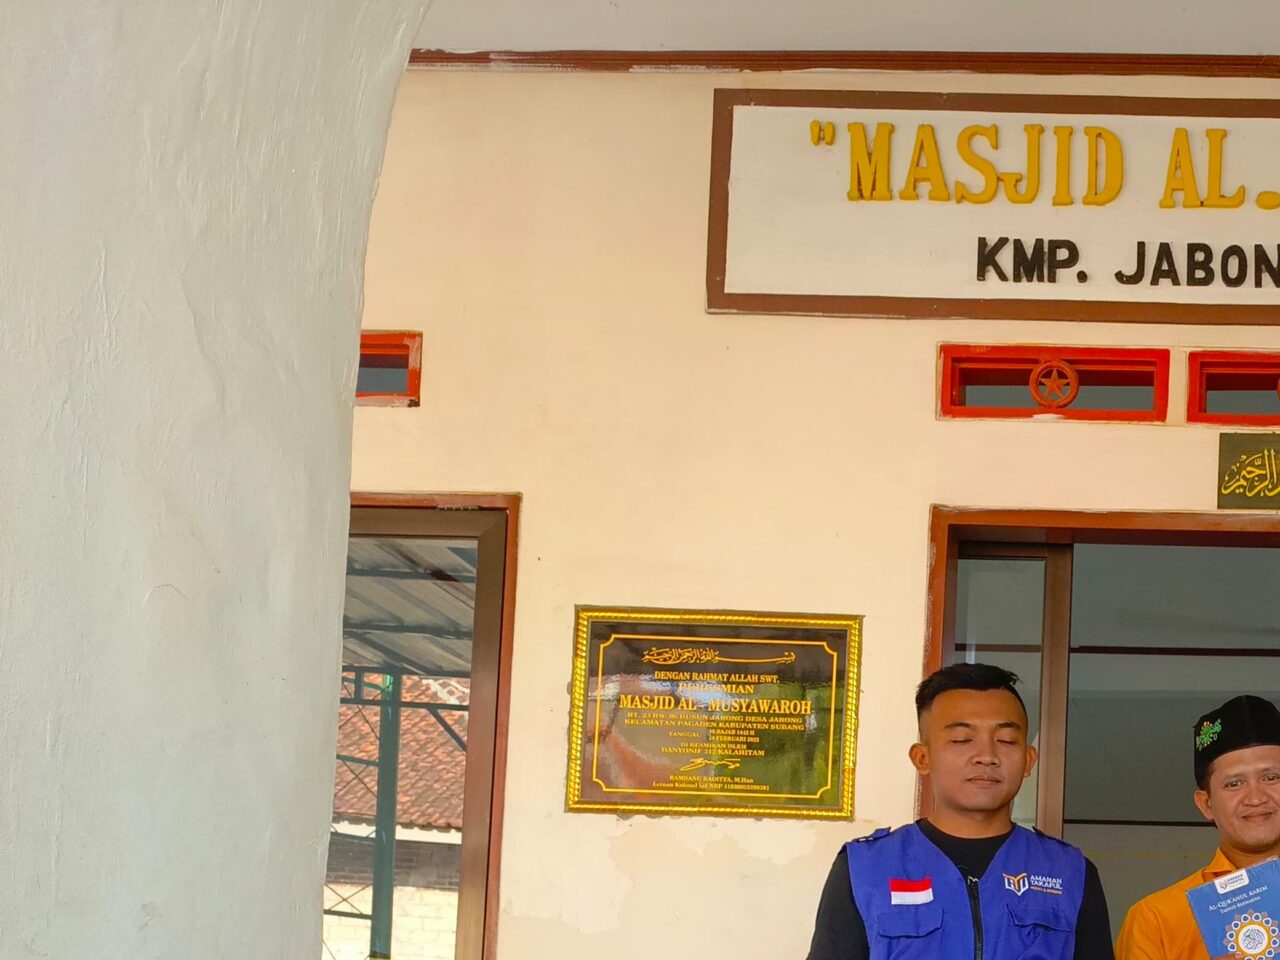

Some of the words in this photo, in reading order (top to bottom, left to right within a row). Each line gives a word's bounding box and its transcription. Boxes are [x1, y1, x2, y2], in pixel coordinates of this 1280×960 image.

[976, 236, 1088, 284] KMP.
[654, 671, 690, 681] DENGAN
[692, 672, 729, 682] RAHMAT
[729, 673, 758, 683] ALLAH
[618, 694, 675, 711] MASJID
[707, 698, 812, 715] MUSYAWAROH
[745, 715, 767, 723] DESA
[1030, 875, 1062, 884] AMANAH
[1031, 880, 1063, 890] TAKAFUL
